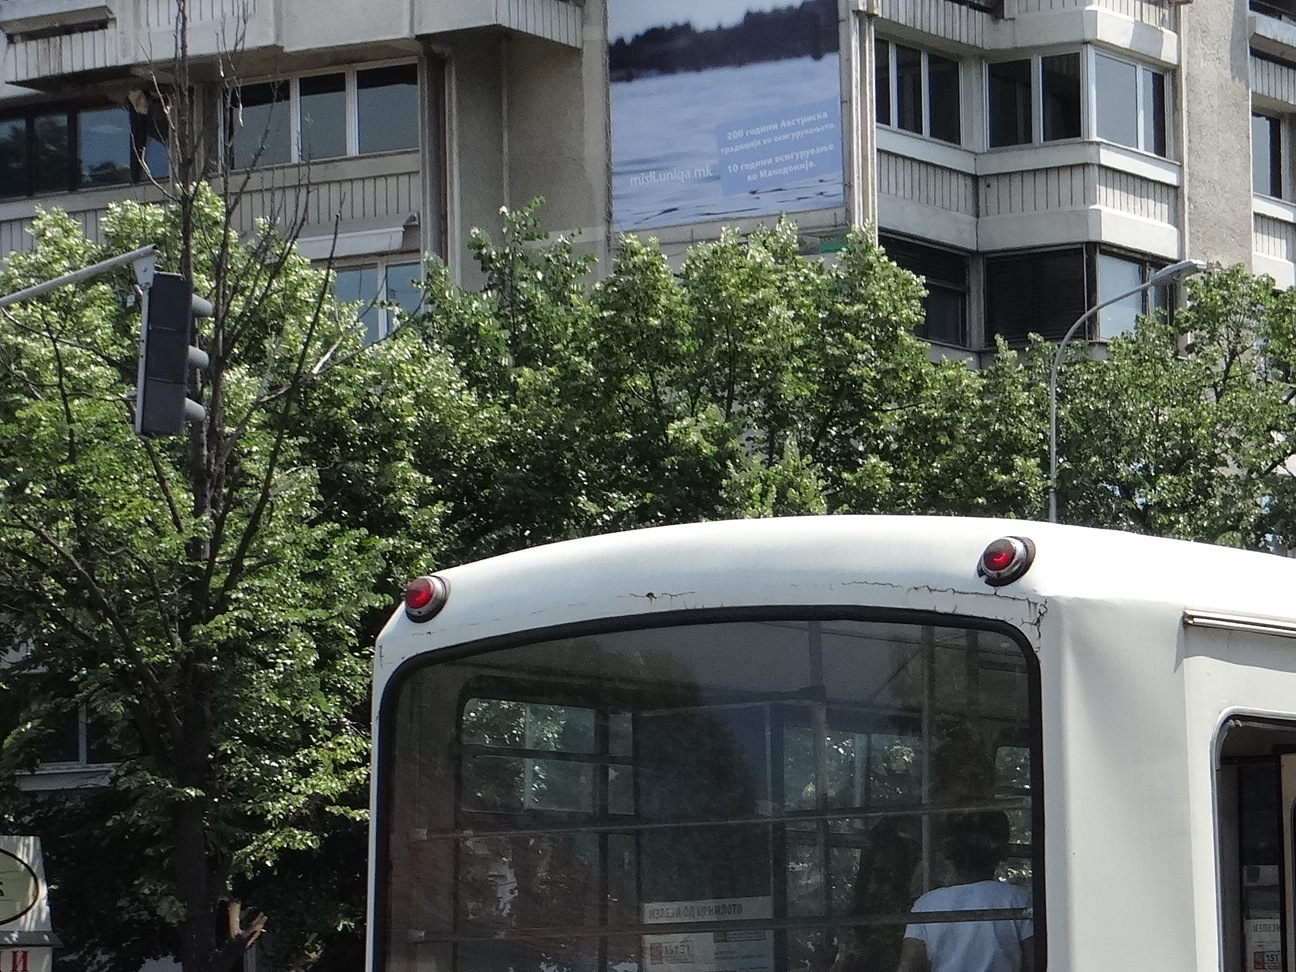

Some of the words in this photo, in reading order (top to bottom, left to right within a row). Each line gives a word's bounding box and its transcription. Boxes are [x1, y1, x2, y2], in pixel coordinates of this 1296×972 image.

[727, 129, 744, 141] 200
[745, 122, 778, 137] години
[780, 111, 828, 129] Австриска
[630, 164, 713, 187] misli.uniqa.mk
[727, 164, 739, 173] 10
[740, 157, 773, 171] години
